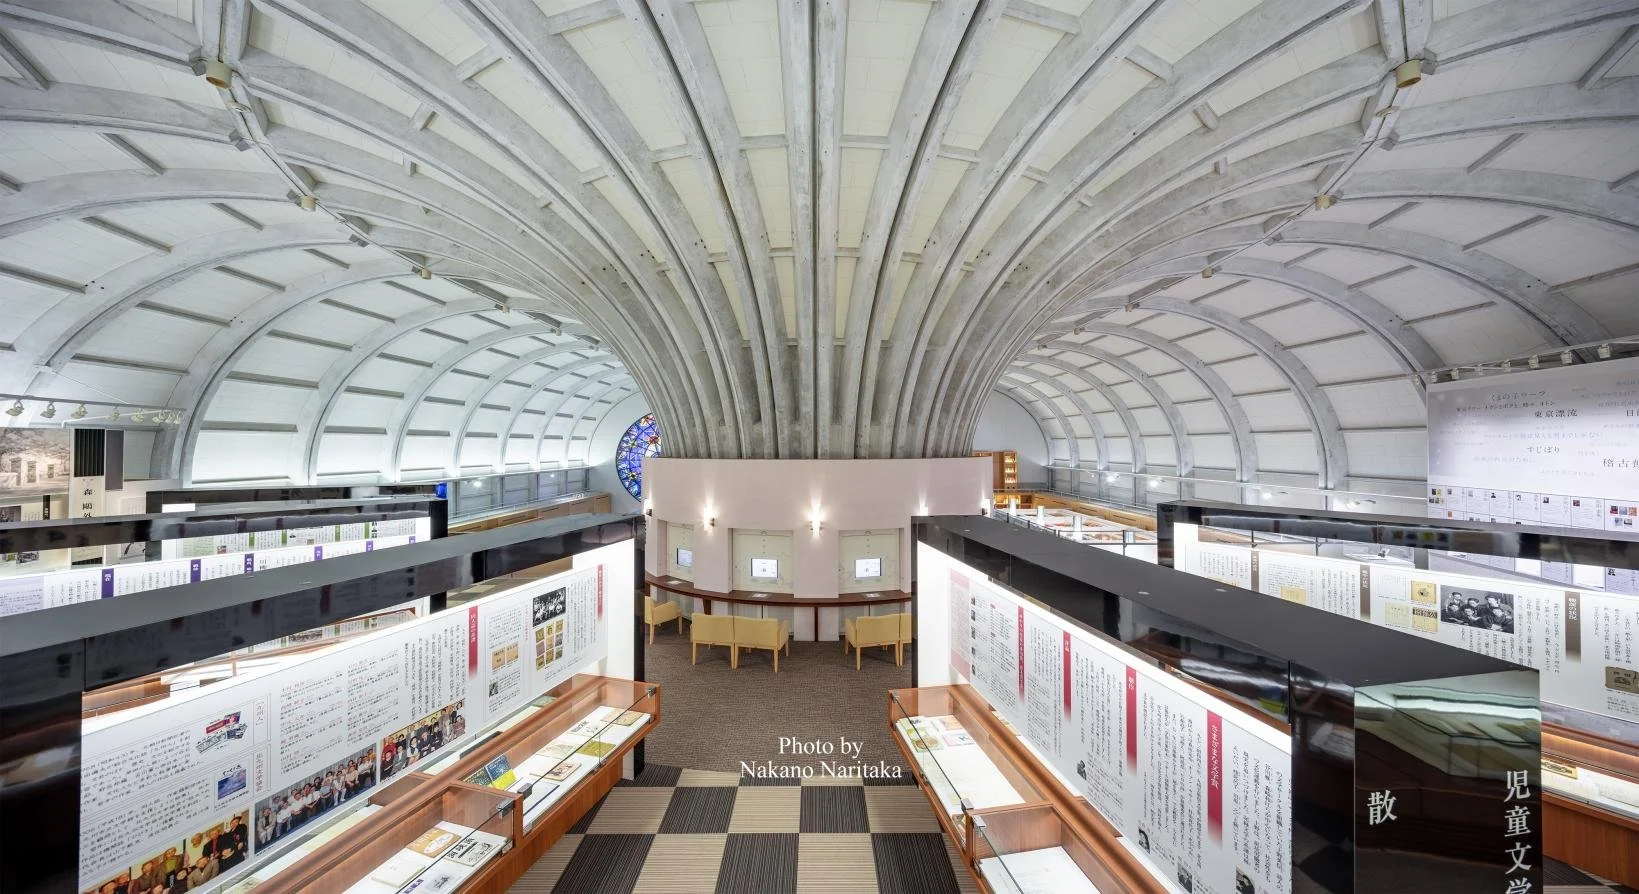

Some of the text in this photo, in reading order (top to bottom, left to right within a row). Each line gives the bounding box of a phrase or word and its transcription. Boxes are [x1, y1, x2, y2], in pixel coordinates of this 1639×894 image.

[1534, 408, 1578, 418] 東京漂流
[1526, 445, 1560, 454] すじぼり
[1367, 789, 1398, 826] 散
